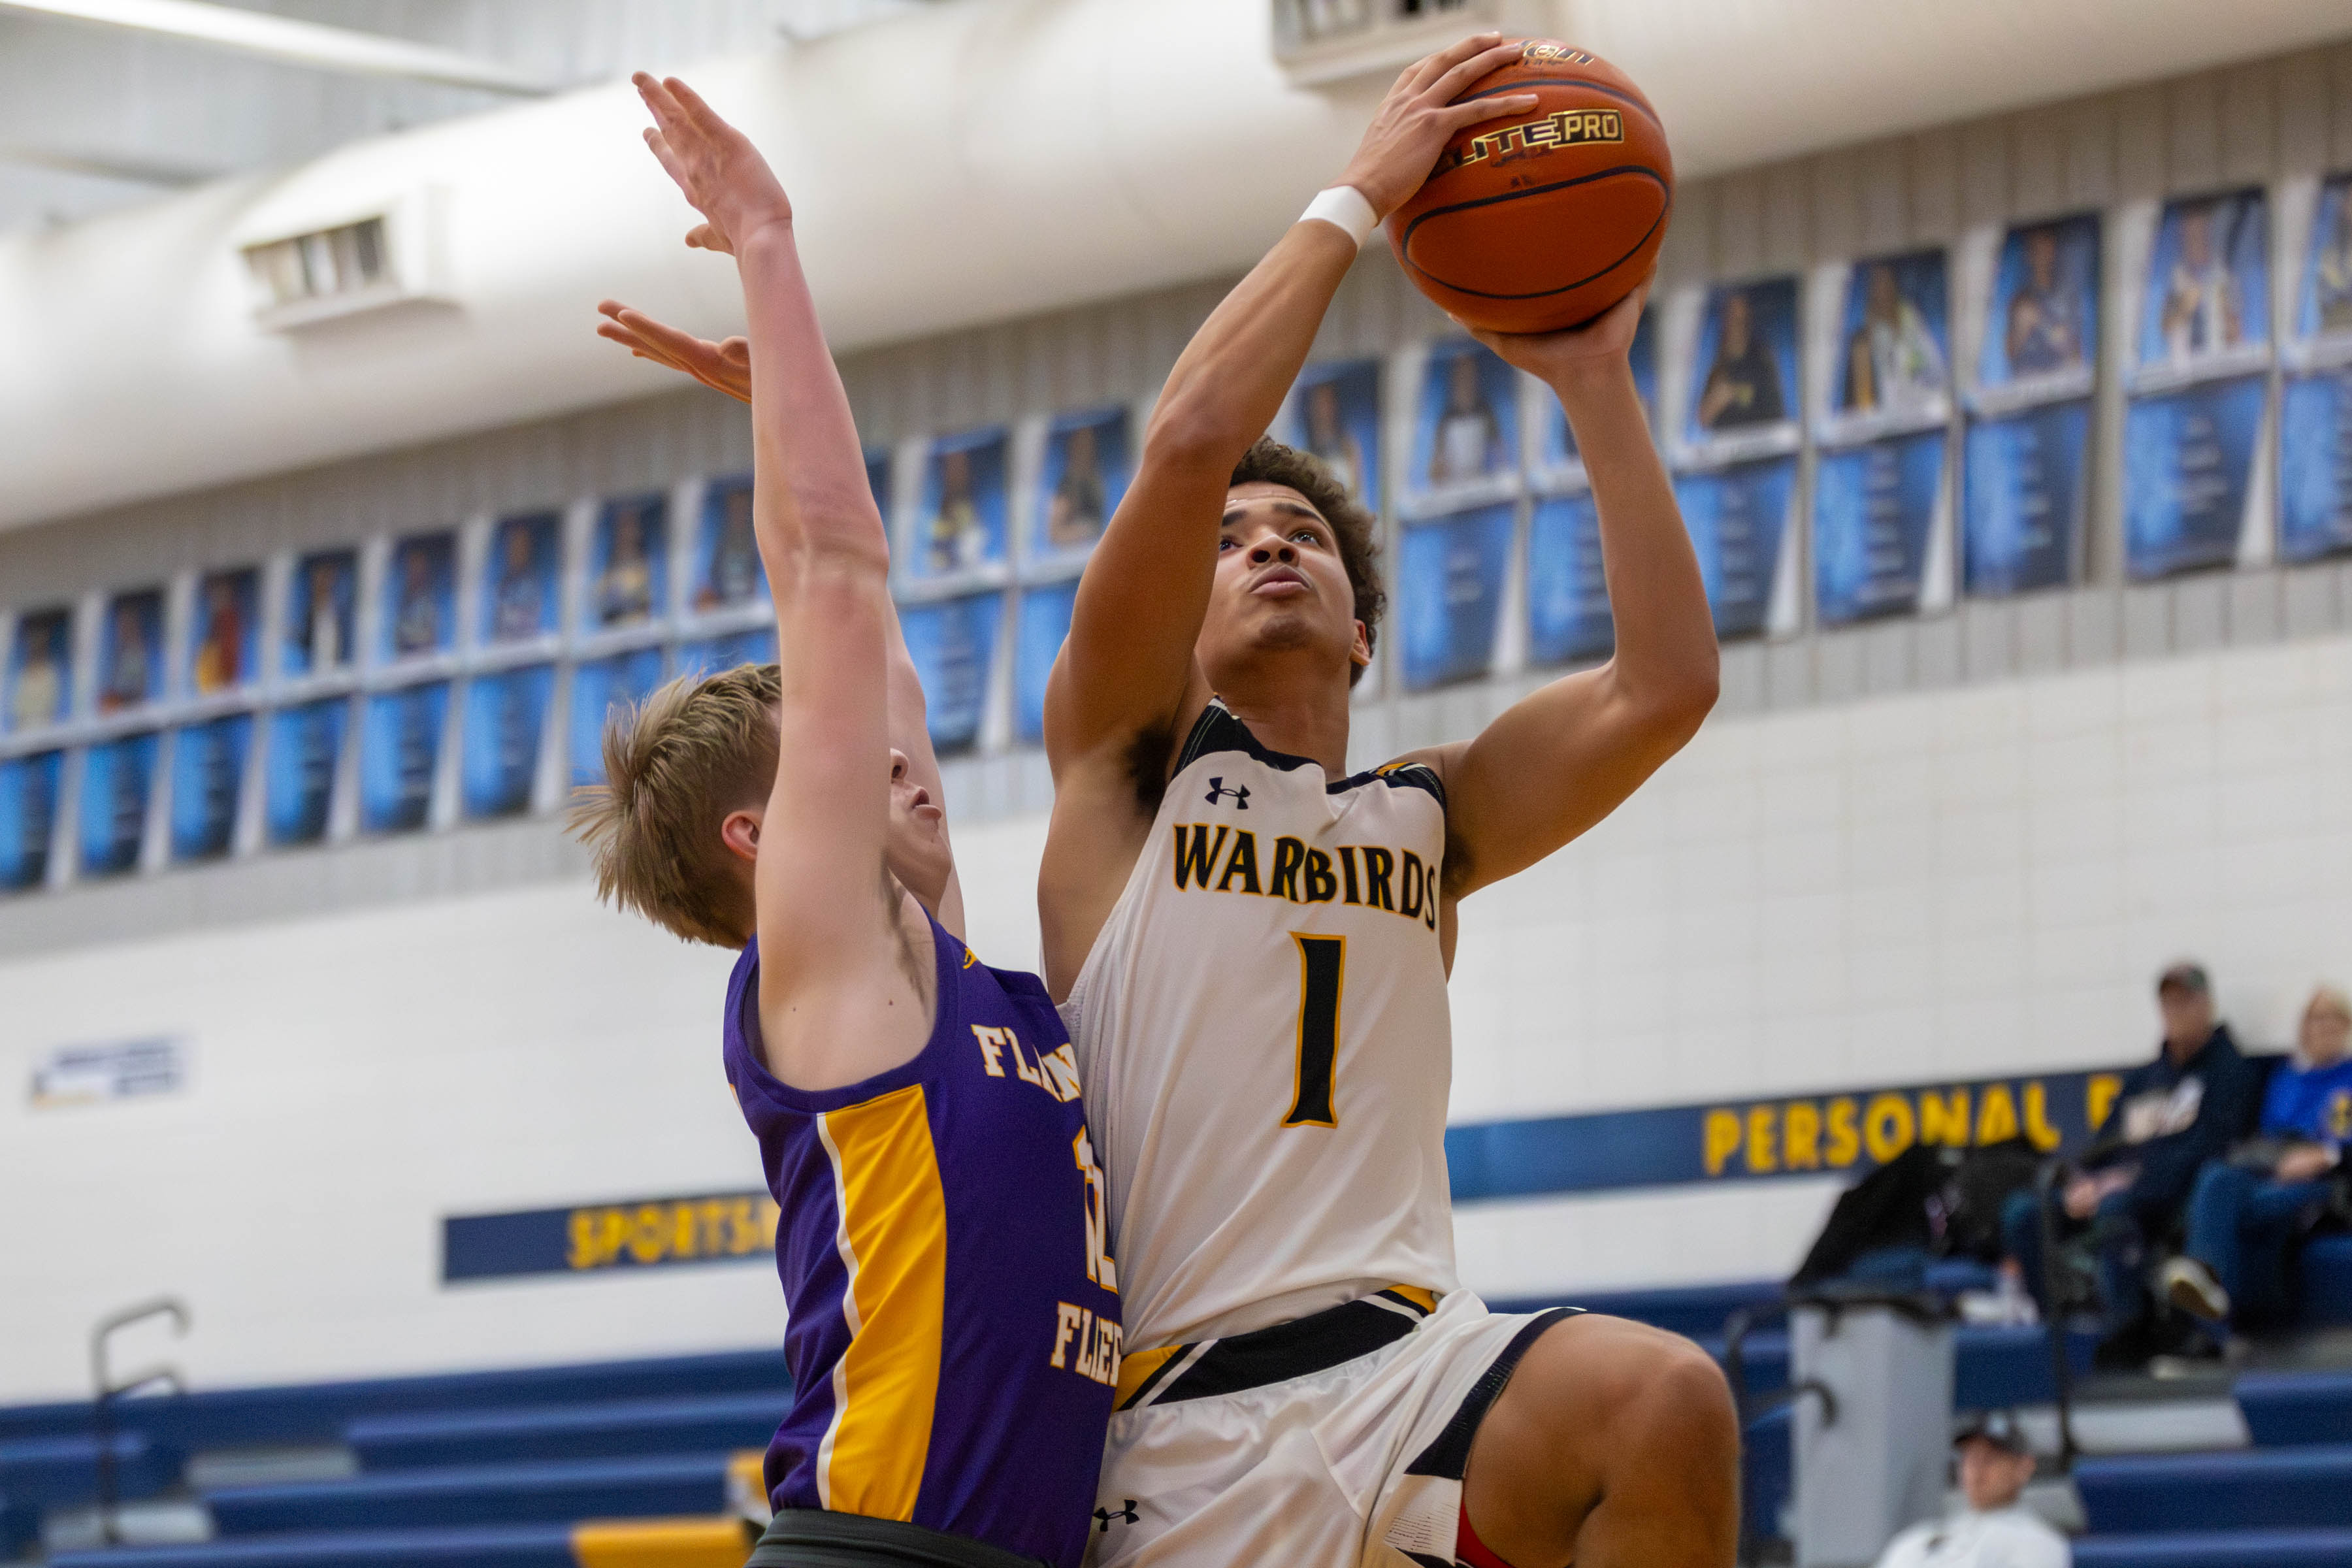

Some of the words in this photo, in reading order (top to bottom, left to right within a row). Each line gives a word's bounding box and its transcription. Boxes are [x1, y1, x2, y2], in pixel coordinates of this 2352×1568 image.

[1439, 119, 1562, 170] LITE
[1563, 114, 1620, 141] PRO
[1172, 822, 1437, 932] WARBIRDS
[1280, 931, 1347, 1129] 1
[1704, 1079, 2061, 1175] PERSONAL
